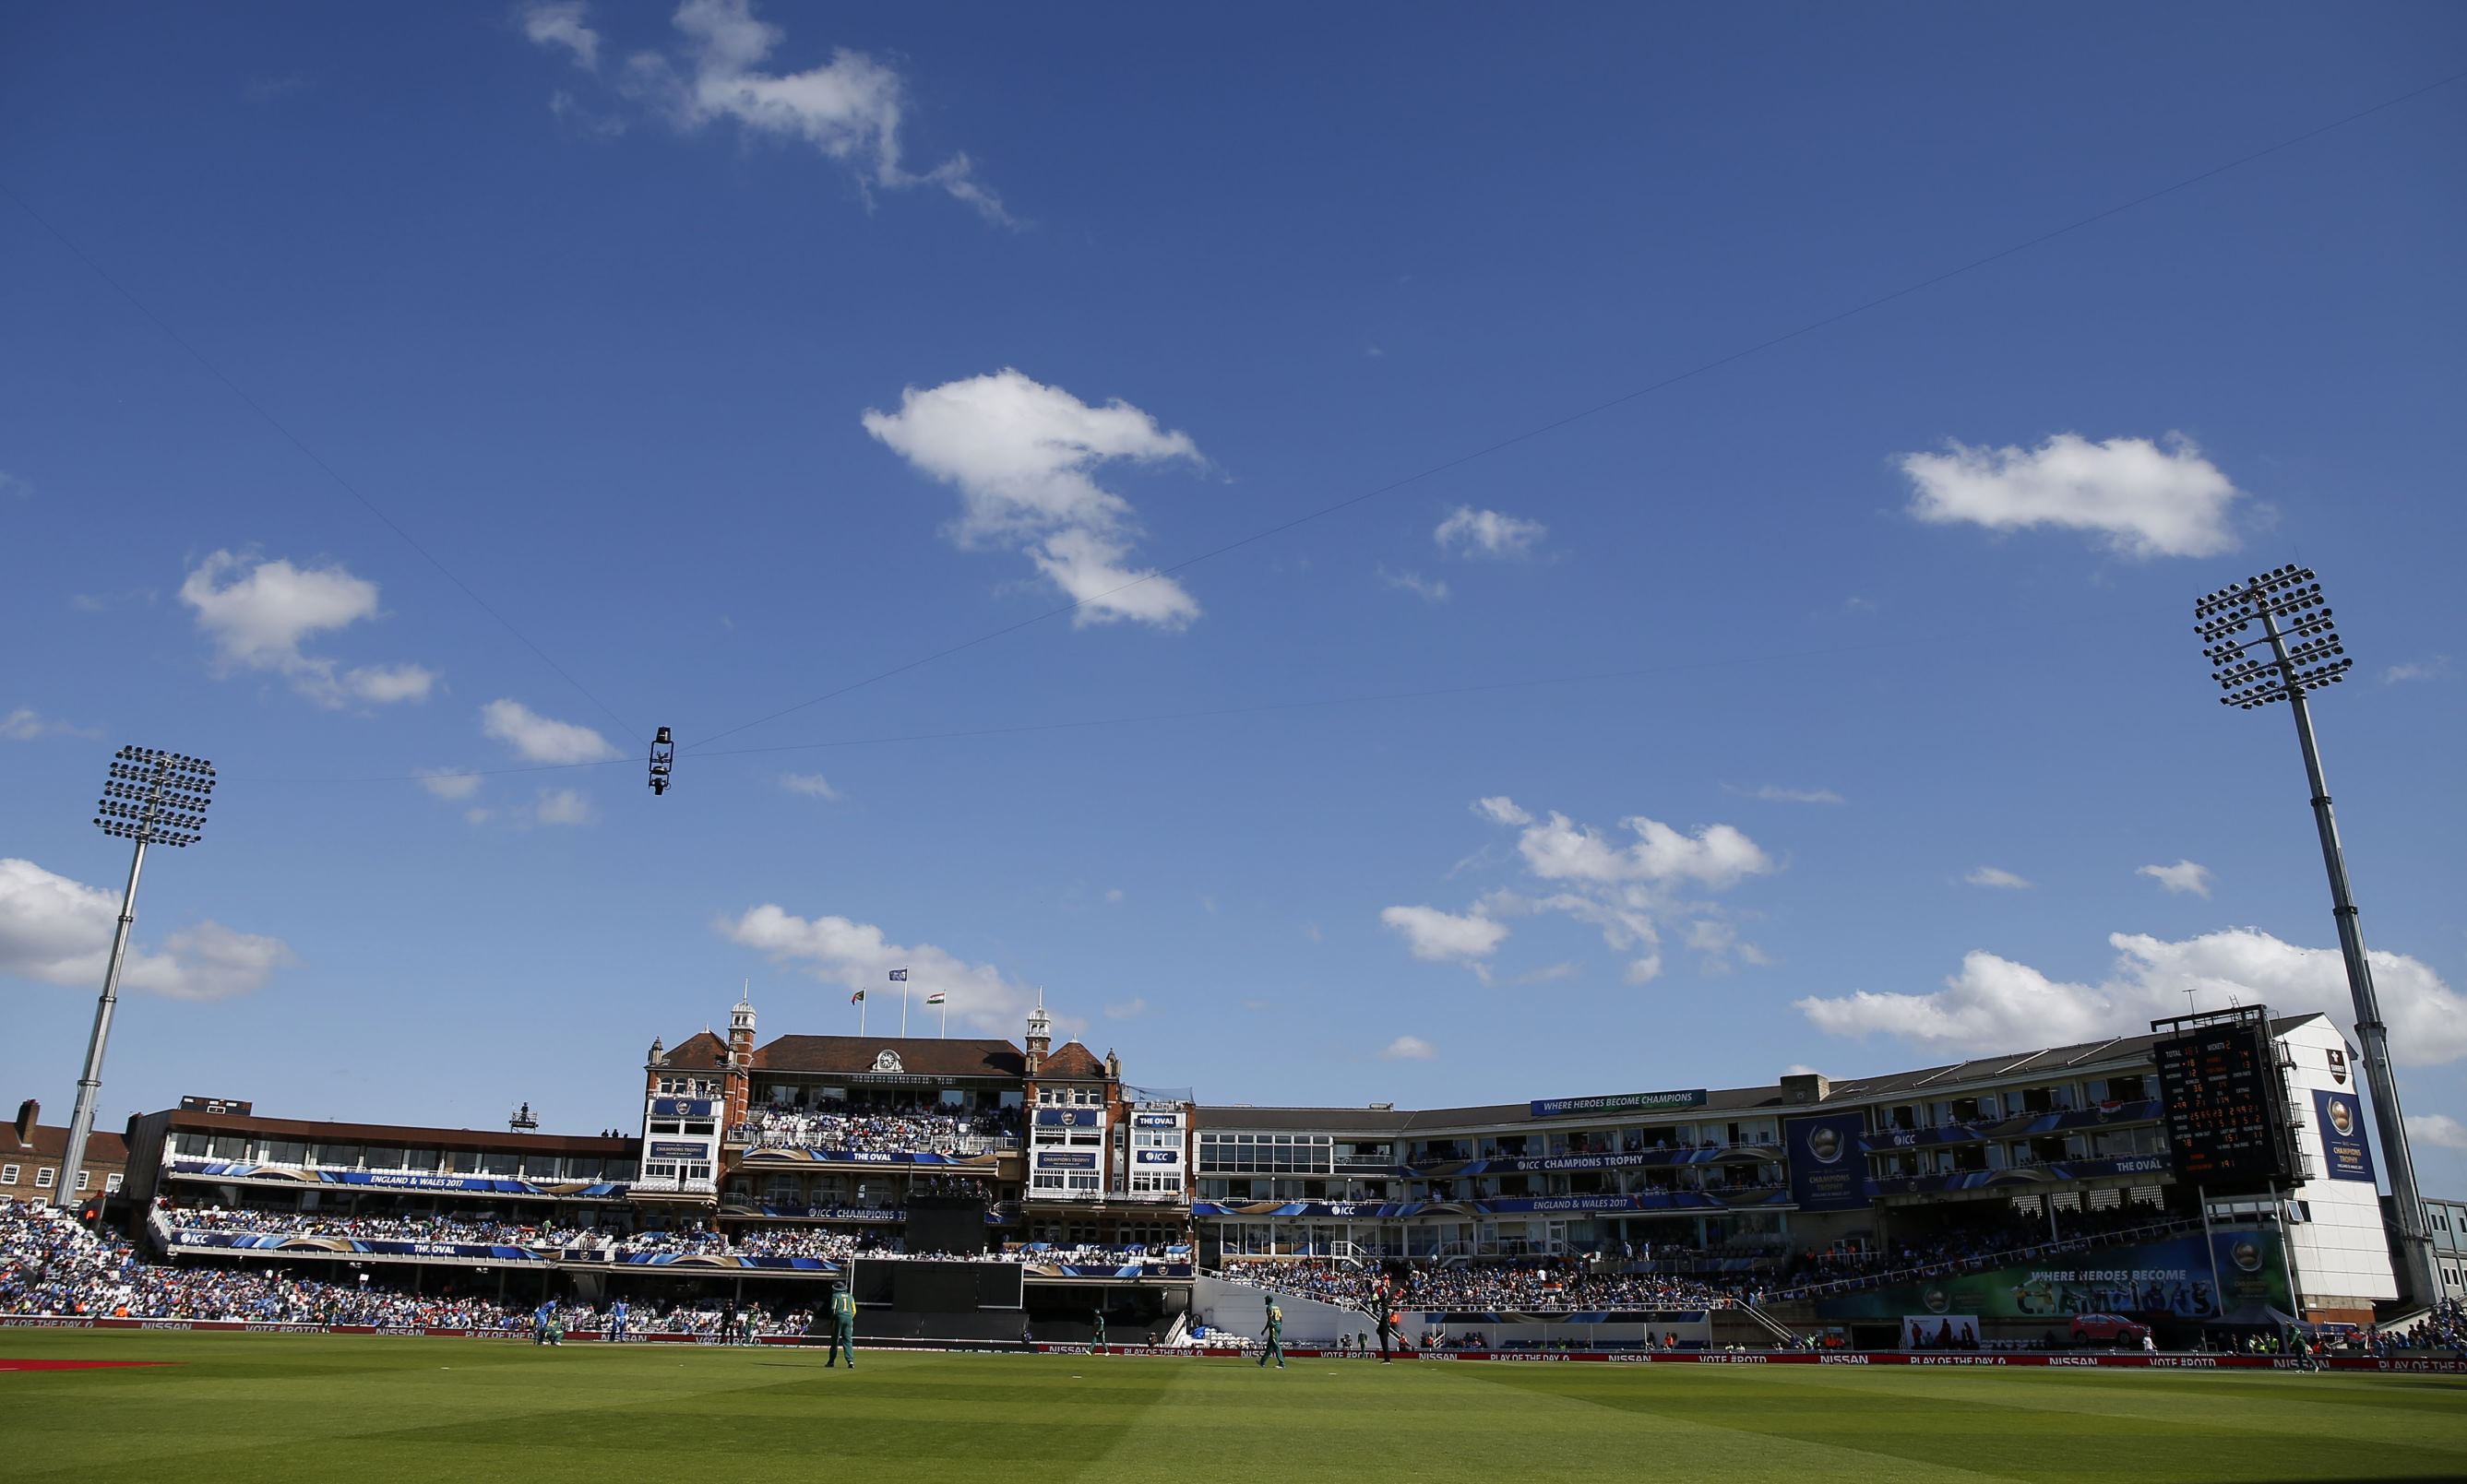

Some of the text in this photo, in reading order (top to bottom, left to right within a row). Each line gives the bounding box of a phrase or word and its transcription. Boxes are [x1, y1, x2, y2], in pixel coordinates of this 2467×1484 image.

[1543, 1093, 1692, 1110] WHERE HEROES BECOME CHAMPIONS
[1902, 1134, 1915, 1145] ICC
[870, 1153, 891, 1161] OVAL
[1526, 1155, 1643, 1169] ICC CHAMPIONS TROPHY
[2116, 1159, 2162, 1171] THE OVAL
[370, 1175, 408, 1184] ENGLAND
[419, 1178, 445, 1186] WALES
[446, 1179, 463, 1187] 2017
[1533, 1199, 1627, 1209] ENGLAND & WALES 2017
[817, 1209, 831, 1217] ICC
[837, 1209, 894, 1219] CHAMPIONS
[1341, 1206, 1355, 1215] ICC
[190, 1234, 209, 1243] ICC
[2032, 1269, 2187, 1282] WHERE HEROES BECOME
[37, 1319, 58, 1328] THE
[60, 1320, 81, 1329] DAY
[141, 1322, 193, 1331] NISSAN
[245, 1324, 276, 1333] VOTE
[375, 1327, 424, 1336] NISSAN
[1820, 1355, 1868, 1364] NISSAN
[2149, 1358, 2177, 1366] VOTE
[2378, 1360, 2409, 1369] PLAY
[2431, 1360, 2455, 1370] THE
